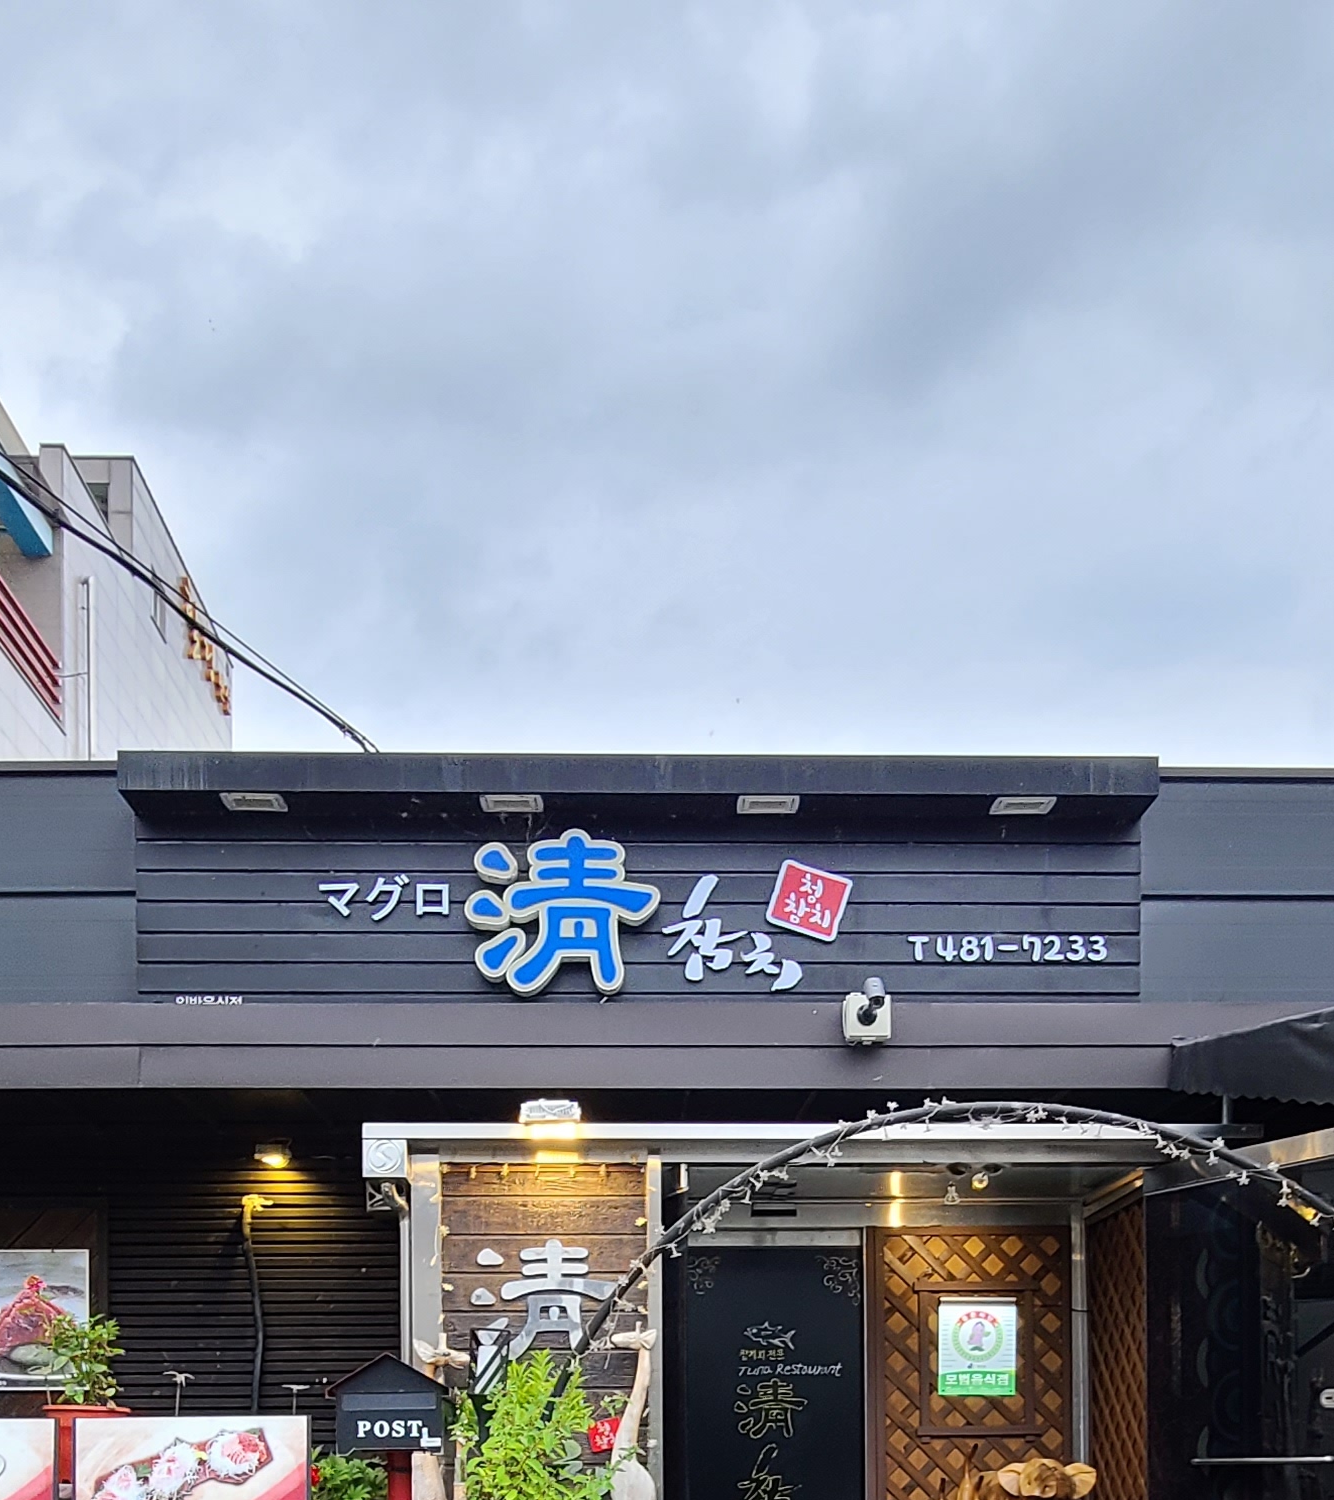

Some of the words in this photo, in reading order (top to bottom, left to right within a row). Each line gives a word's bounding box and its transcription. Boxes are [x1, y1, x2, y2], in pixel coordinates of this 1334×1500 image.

[318, 876, 452, 918] マグロ
[798, 872, 824, 904] 청
[465, 828, 661, 997] 清
[945, 1373, 1010, 1386] 모범음식점
[357, 1420, 423, 1438] POST
